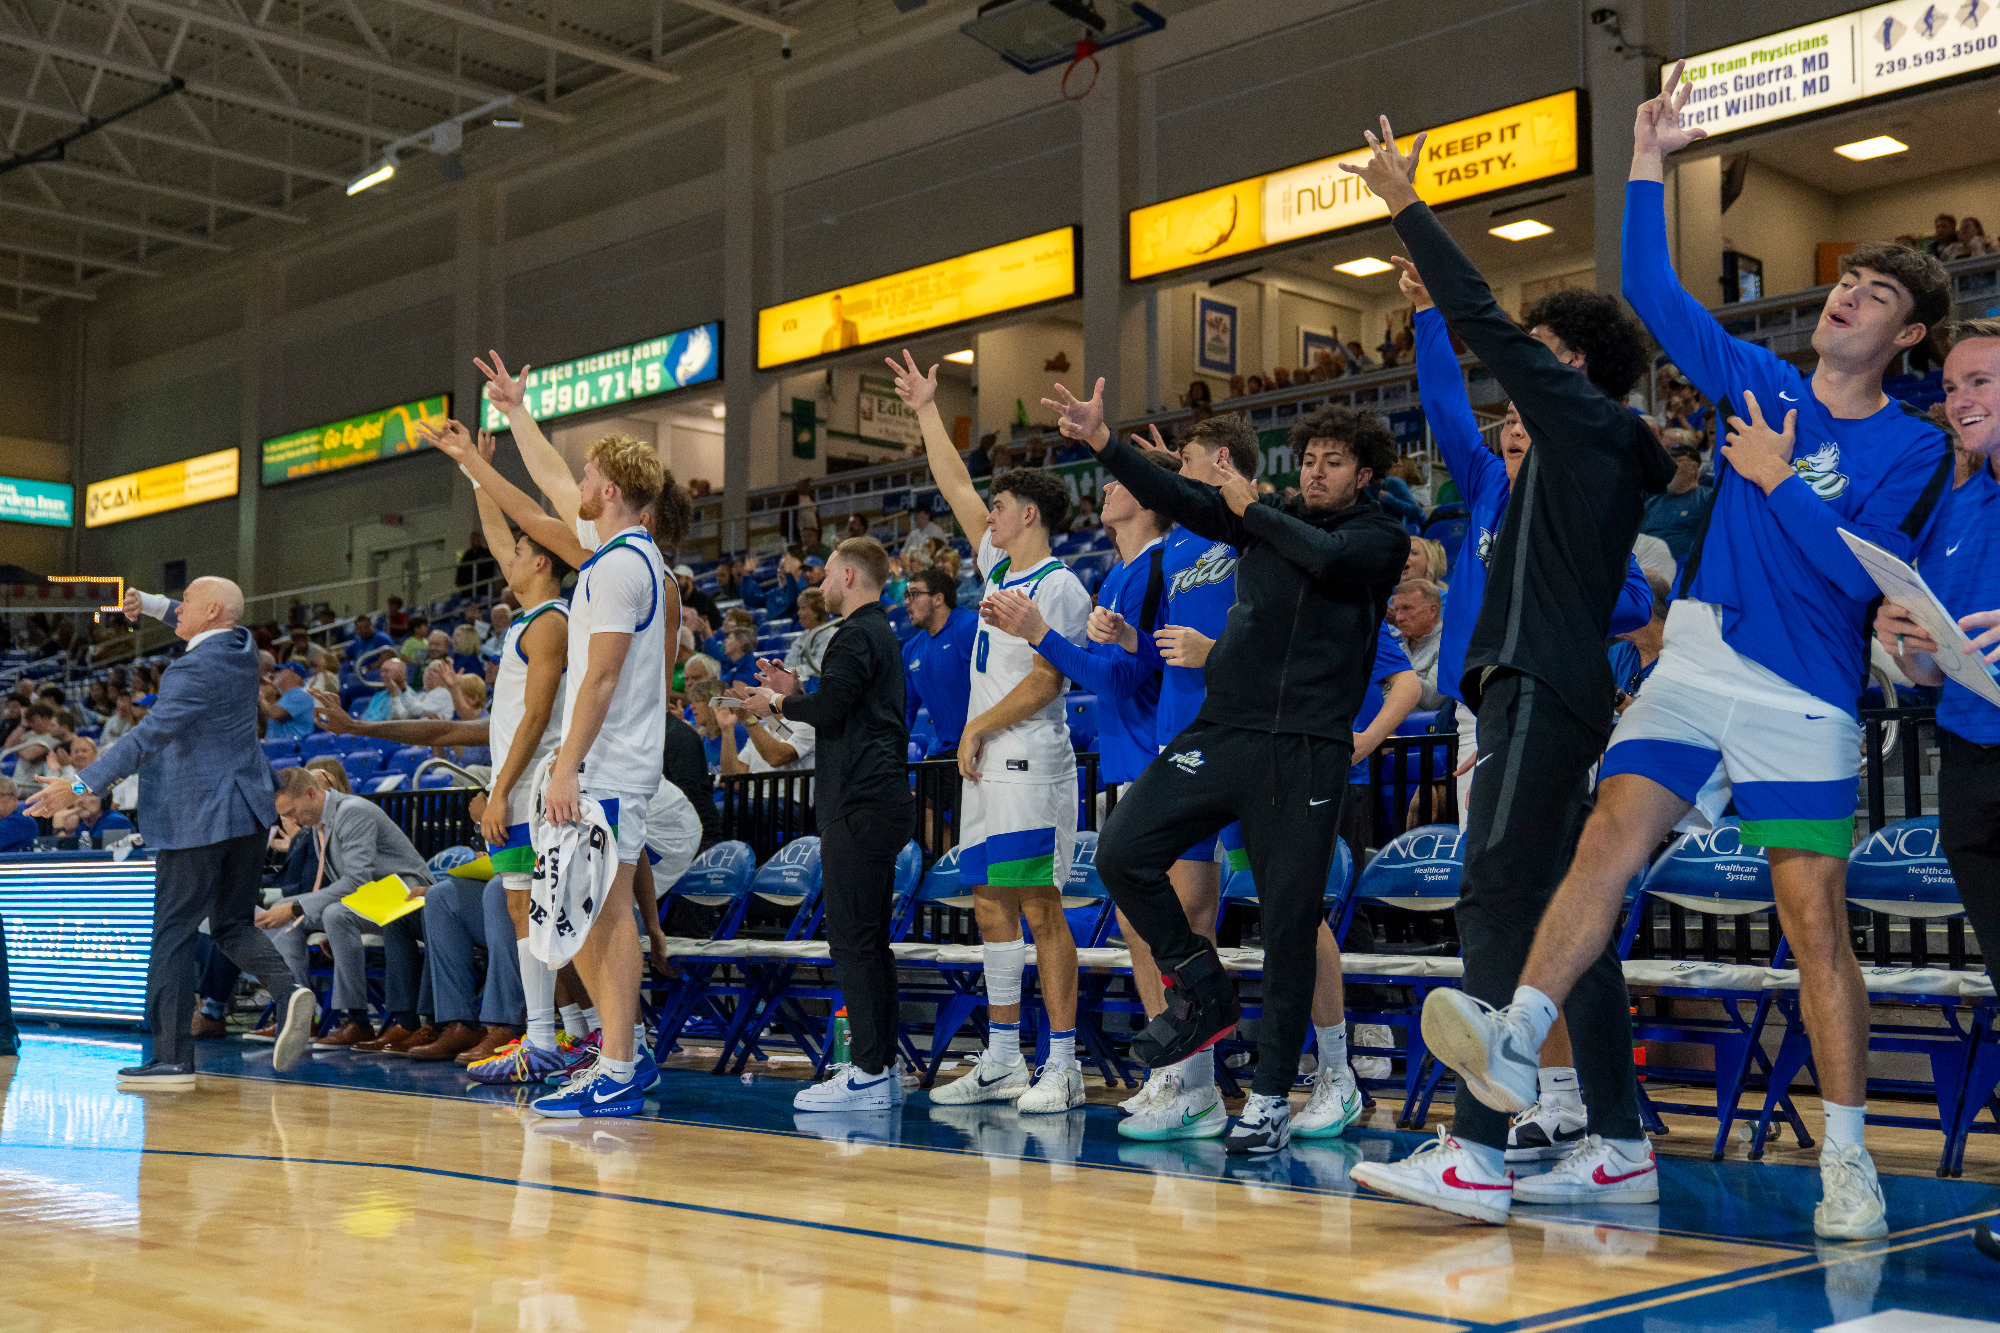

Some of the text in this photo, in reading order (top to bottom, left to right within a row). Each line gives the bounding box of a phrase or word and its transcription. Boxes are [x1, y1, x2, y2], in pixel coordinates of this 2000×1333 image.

[1711, 55, 1748, 76] Team
[1751, 34, 1829, 66] Physicians
[1802, 52, 1829, 73] MD
[1875, 35, 1998, 77] 239.593.3500
[1803, 75, 1830, 96] MD
[1428, 123, 1521, 162] KEEP IT
[1434, 153, 1517, 187] TASTY.
[576, 349, 630, 374] TICKETS
[632, 339, 668, 362] NOW!
[1169, 557, 1238, 602] FGCU
[976, 630, 989, 673] 0
[693, 848, 740, 867] NCH
[771, 843, 815, 864] NCH
[1382, 834, 1461, 859] NCH
[1423, 873, 1449, 882] System
[1714, 863, 1758, 873] Healthcare
[1726, 872, 1756, 881] System
